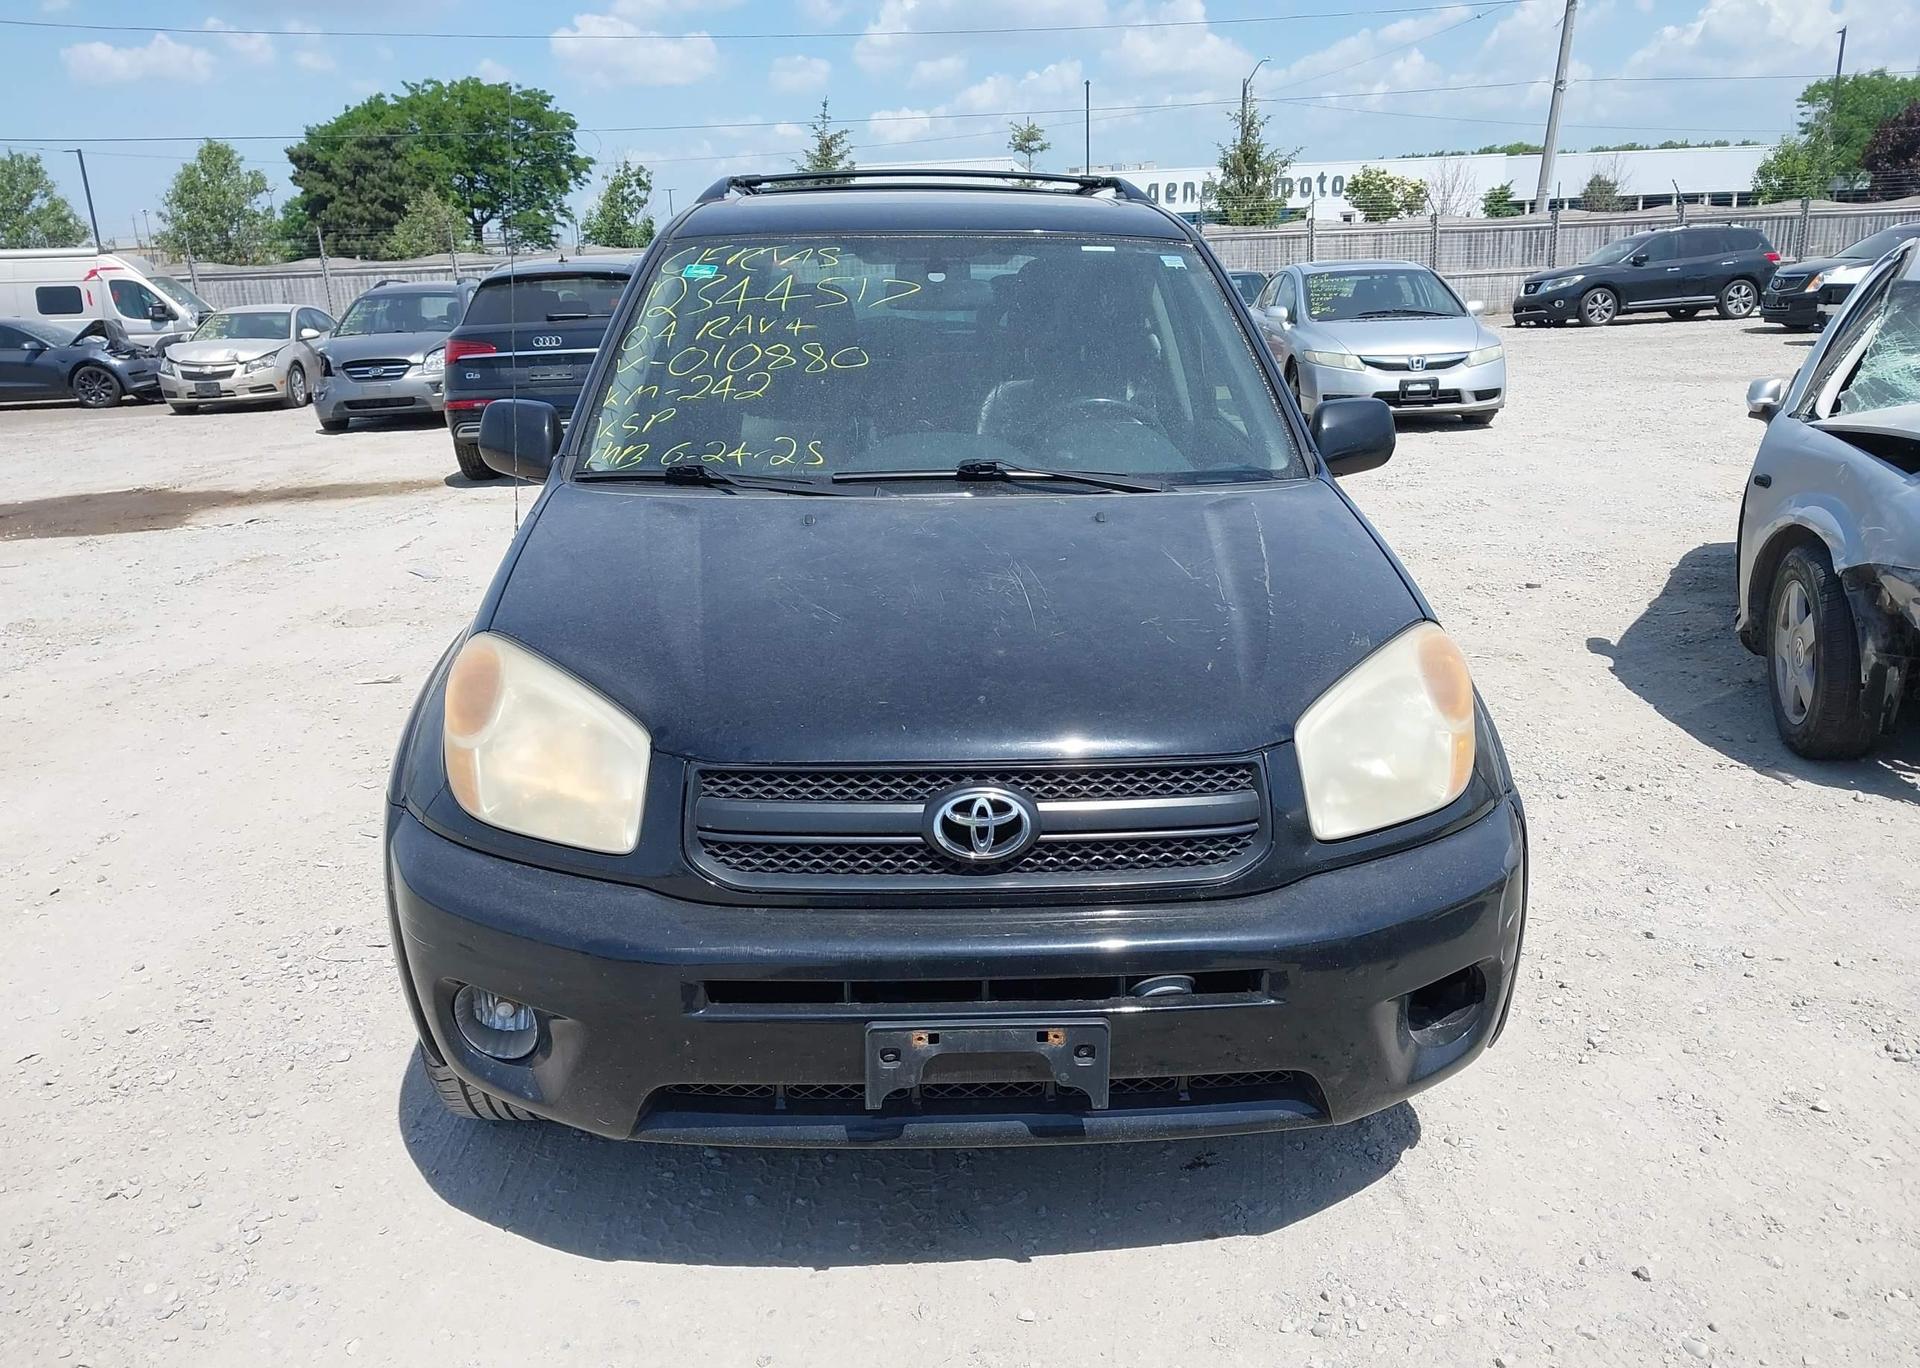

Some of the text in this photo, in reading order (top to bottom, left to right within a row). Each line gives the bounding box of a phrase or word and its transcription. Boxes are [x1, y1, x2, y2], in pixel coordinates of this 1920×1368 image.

[1273, 171, 1345, 198] moto
[621, 314, 817, 352] 04 RAV4
[616, 342, 870, 376] V-010880
[660, 436, 825, 468] 6-24-25
